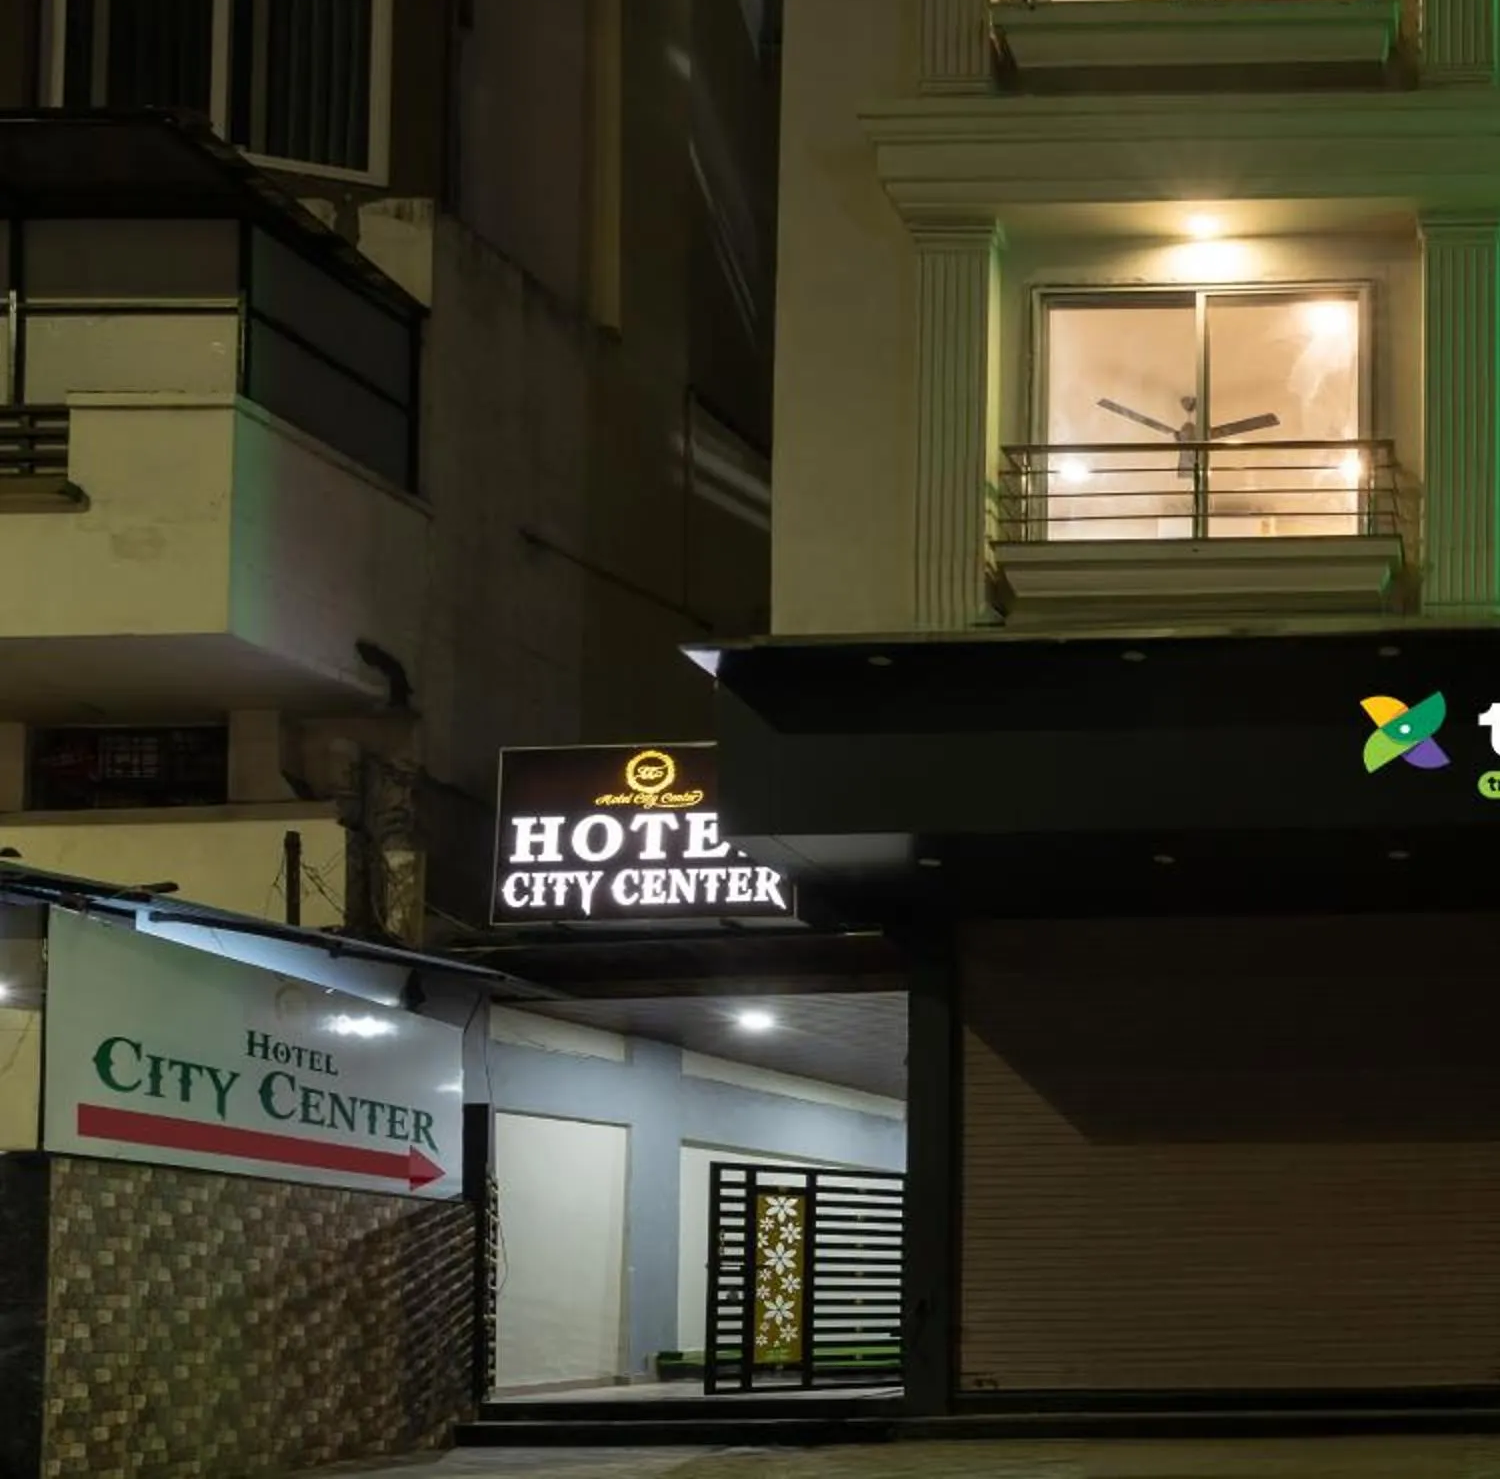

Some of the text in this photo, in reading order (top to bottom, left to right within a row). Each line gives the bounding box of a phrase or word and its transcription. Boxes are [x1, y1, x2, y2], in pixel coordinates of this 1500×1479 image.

[510, 812, 747, 863] HOTE
[502, 866, 787, 916] CITY CENTER
[246, 1029, 339, 1077] HOTEL
[93, 1036, 439, 1152] CITY CENTER
